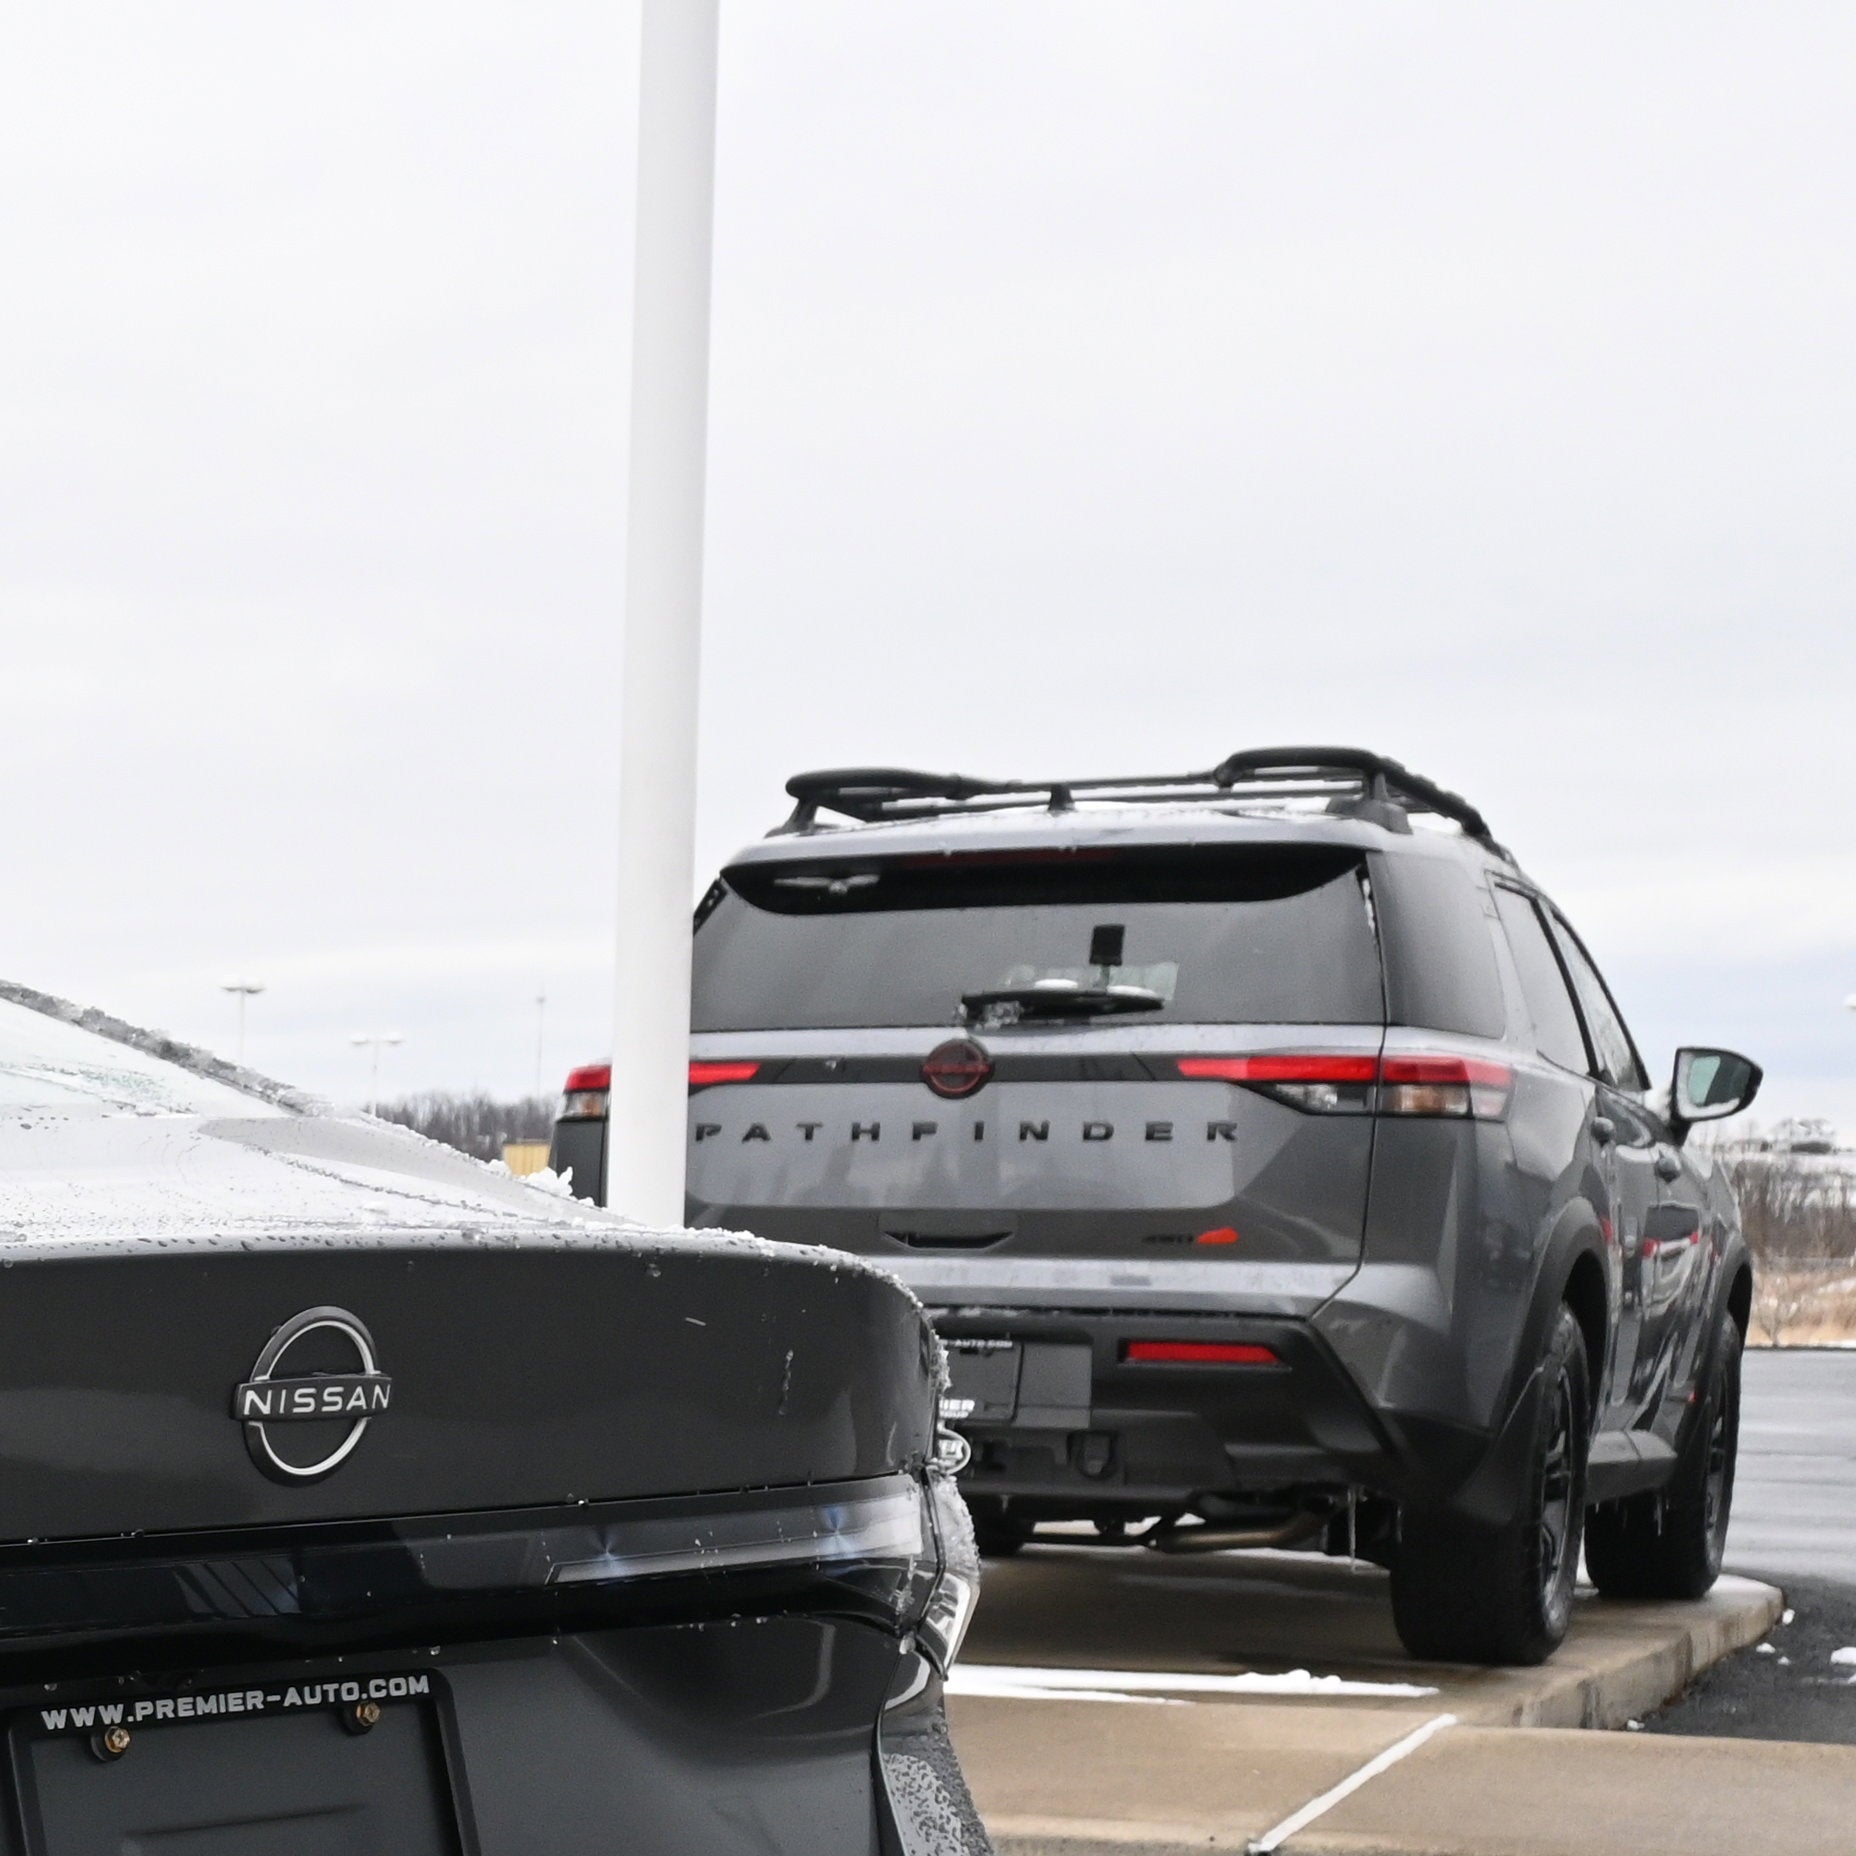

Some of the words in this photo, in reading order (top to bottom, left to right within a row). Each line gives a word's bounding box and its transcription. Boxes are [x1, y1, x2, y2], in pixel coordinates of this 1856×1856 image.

[695, 1121, 1238, 1143] PATHFINDER
[242, 1383, 391, 1416] NISSAN
[41, 1674, 431, 1731] WWW.PREMIER-AUTO.COM
